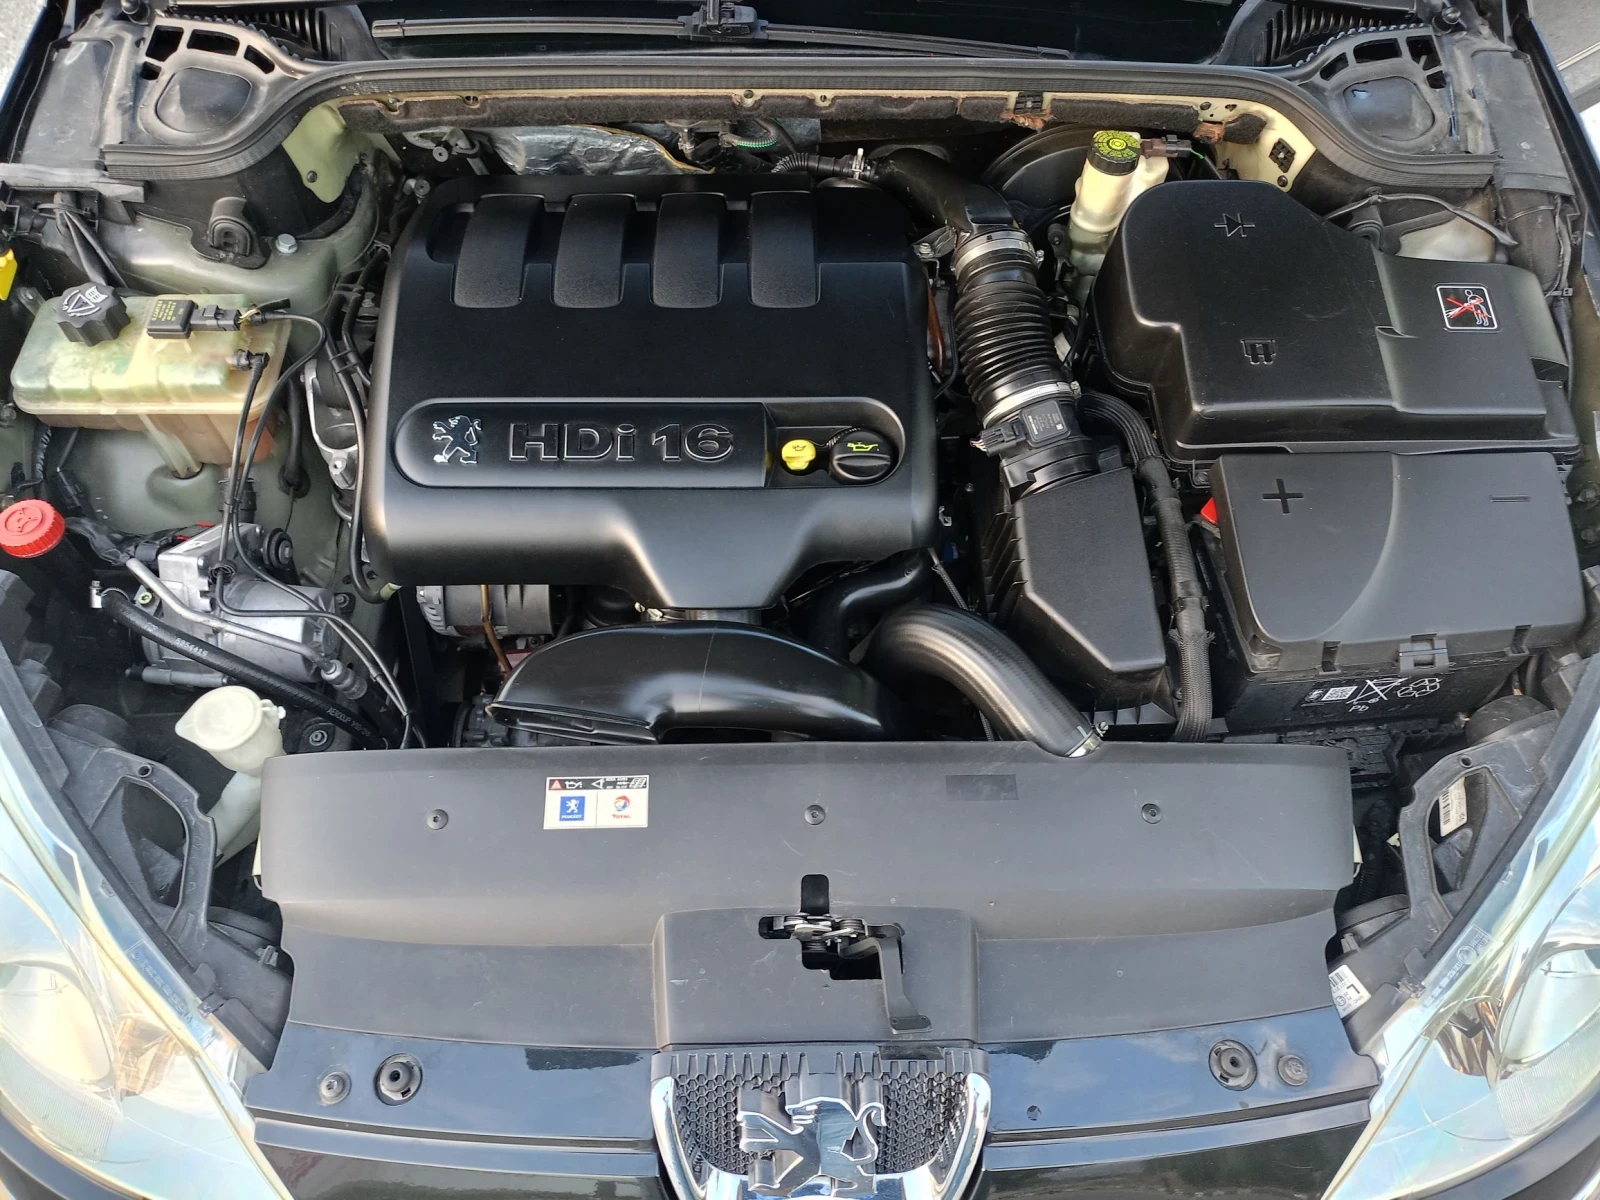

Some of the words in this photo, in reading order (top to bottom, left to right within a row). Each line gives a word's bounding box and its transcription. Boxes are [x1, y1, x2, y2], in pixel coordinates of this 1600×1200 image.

[509, 423, 635, 461] HDi
[652, 423, 733, 462] 16
[1348, 704, 1369, 712] Pb
